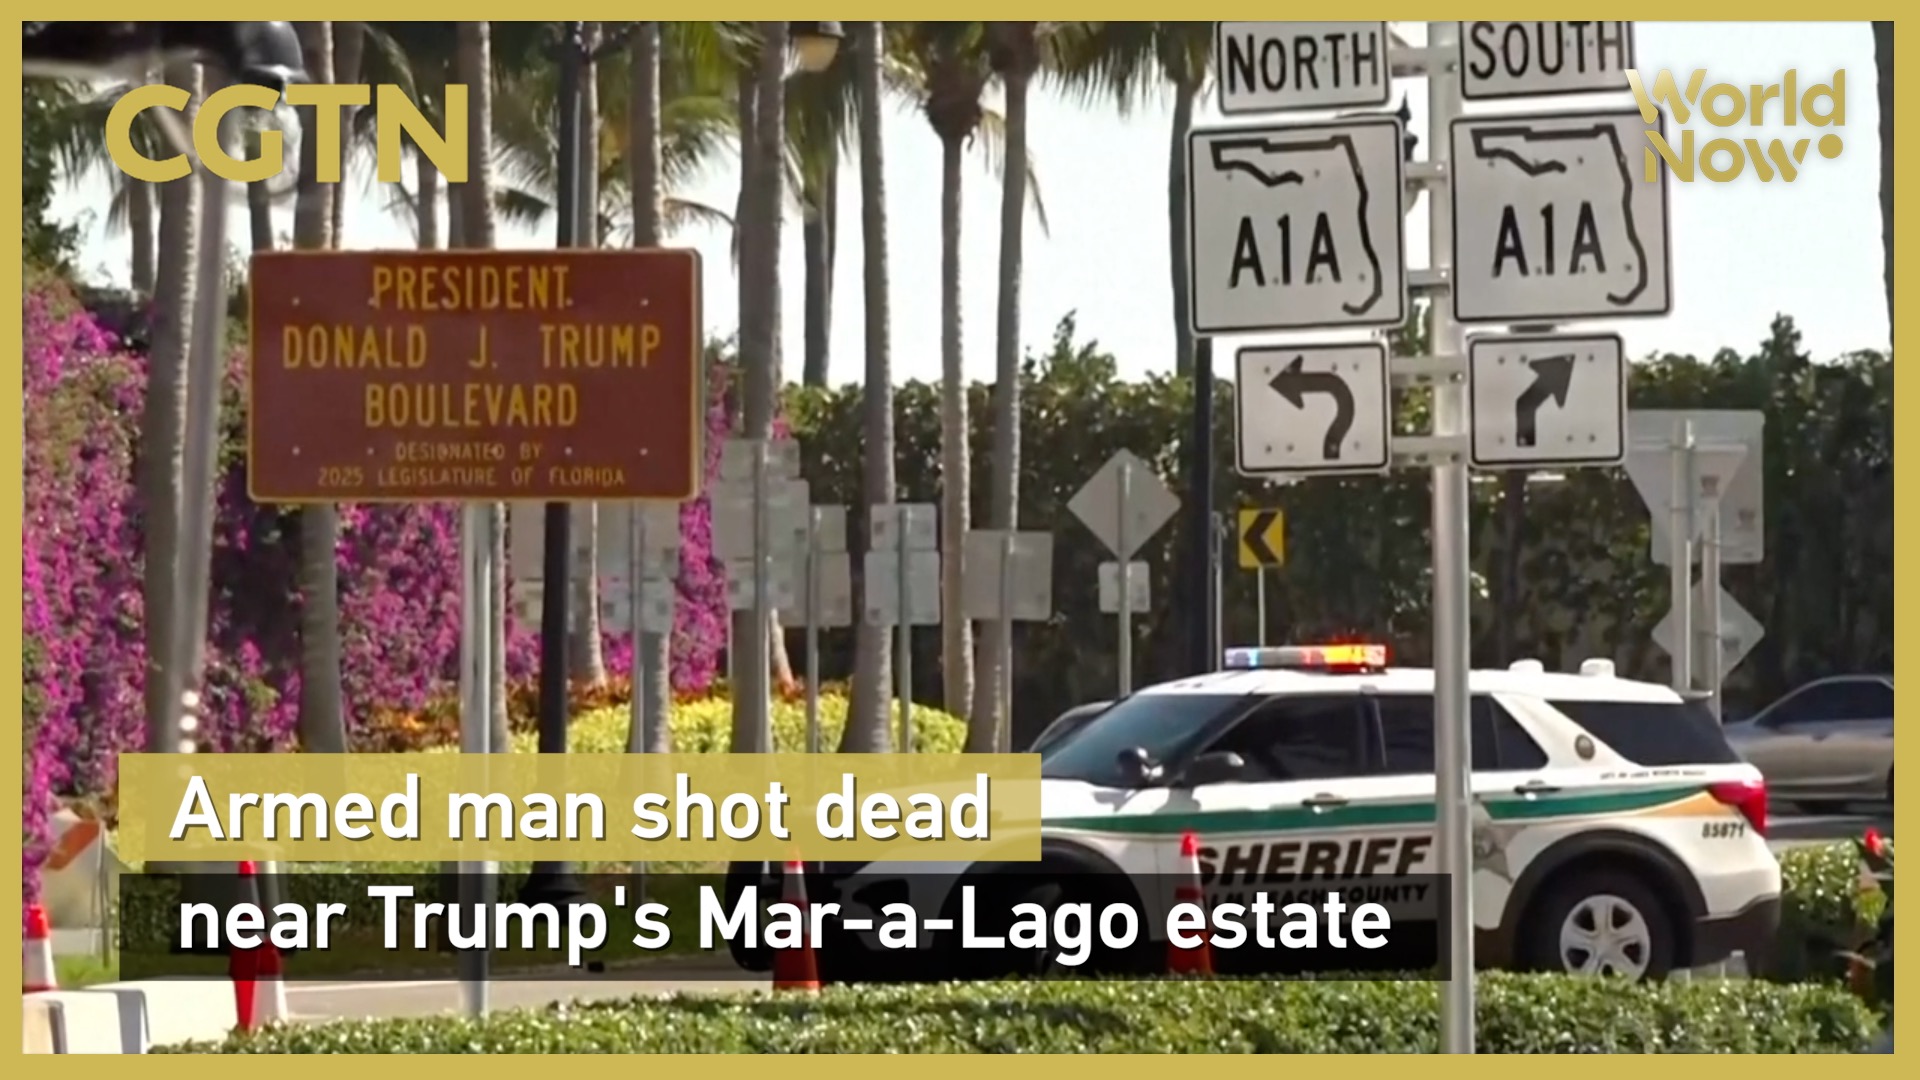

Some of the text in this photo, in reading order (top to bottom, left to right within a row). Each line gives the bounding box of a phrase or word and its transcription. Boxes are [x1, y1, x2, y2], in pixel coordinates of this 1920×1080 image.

[1226, 31, 1379, 95] NORTH
[1469, 21, 1625, 80] SOUTH
[1228, 211, 1342, 289] A1A
[1491, 200, 1607, 278] A1A
[372, 265, 570, 310] PRESIDENT
[282, 324, 661, 370] DONALD J. TRUMP
[364, 383, 578, 428] BOULEVARD
[395, 442, 543, 461] DESIGNATED BY
[317, 466, 626, 487] 2025 LEGISLATURE OF FLORIDA
[1196, 836, 1433, 886] SHERIFF
[1251, 886, 1328, 909] EACH
